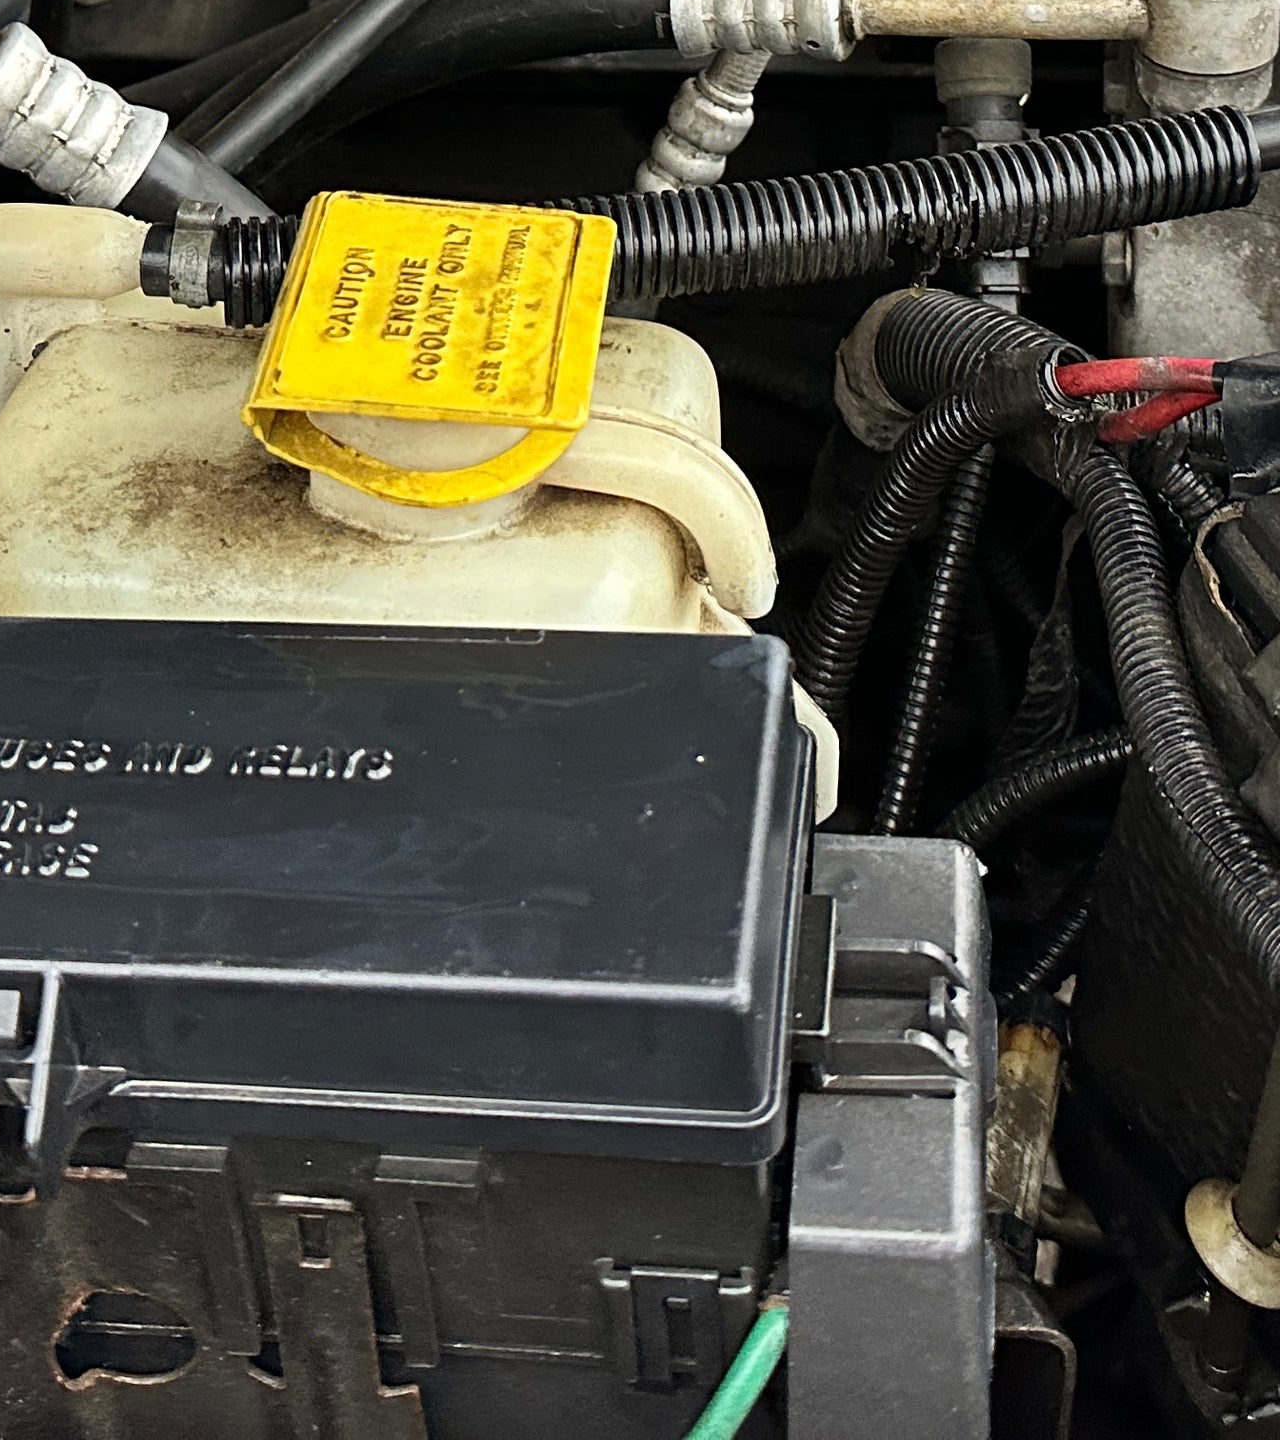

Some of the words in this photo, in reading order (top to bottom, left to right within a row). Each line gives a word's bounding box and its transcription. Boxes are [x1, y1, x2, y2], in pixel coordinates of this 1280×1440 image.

[320, 246, 375, 339] CAUTION
[380, 256, 428, 340] ENGINE
[408, 283, 458, 381] COOLANT
[435, 223, 473, 275] ONLY
[473, 359, 501, 394] SEE
[124, 741, 212, 775] AND
[230, 743, 394, 781] RELAYS
